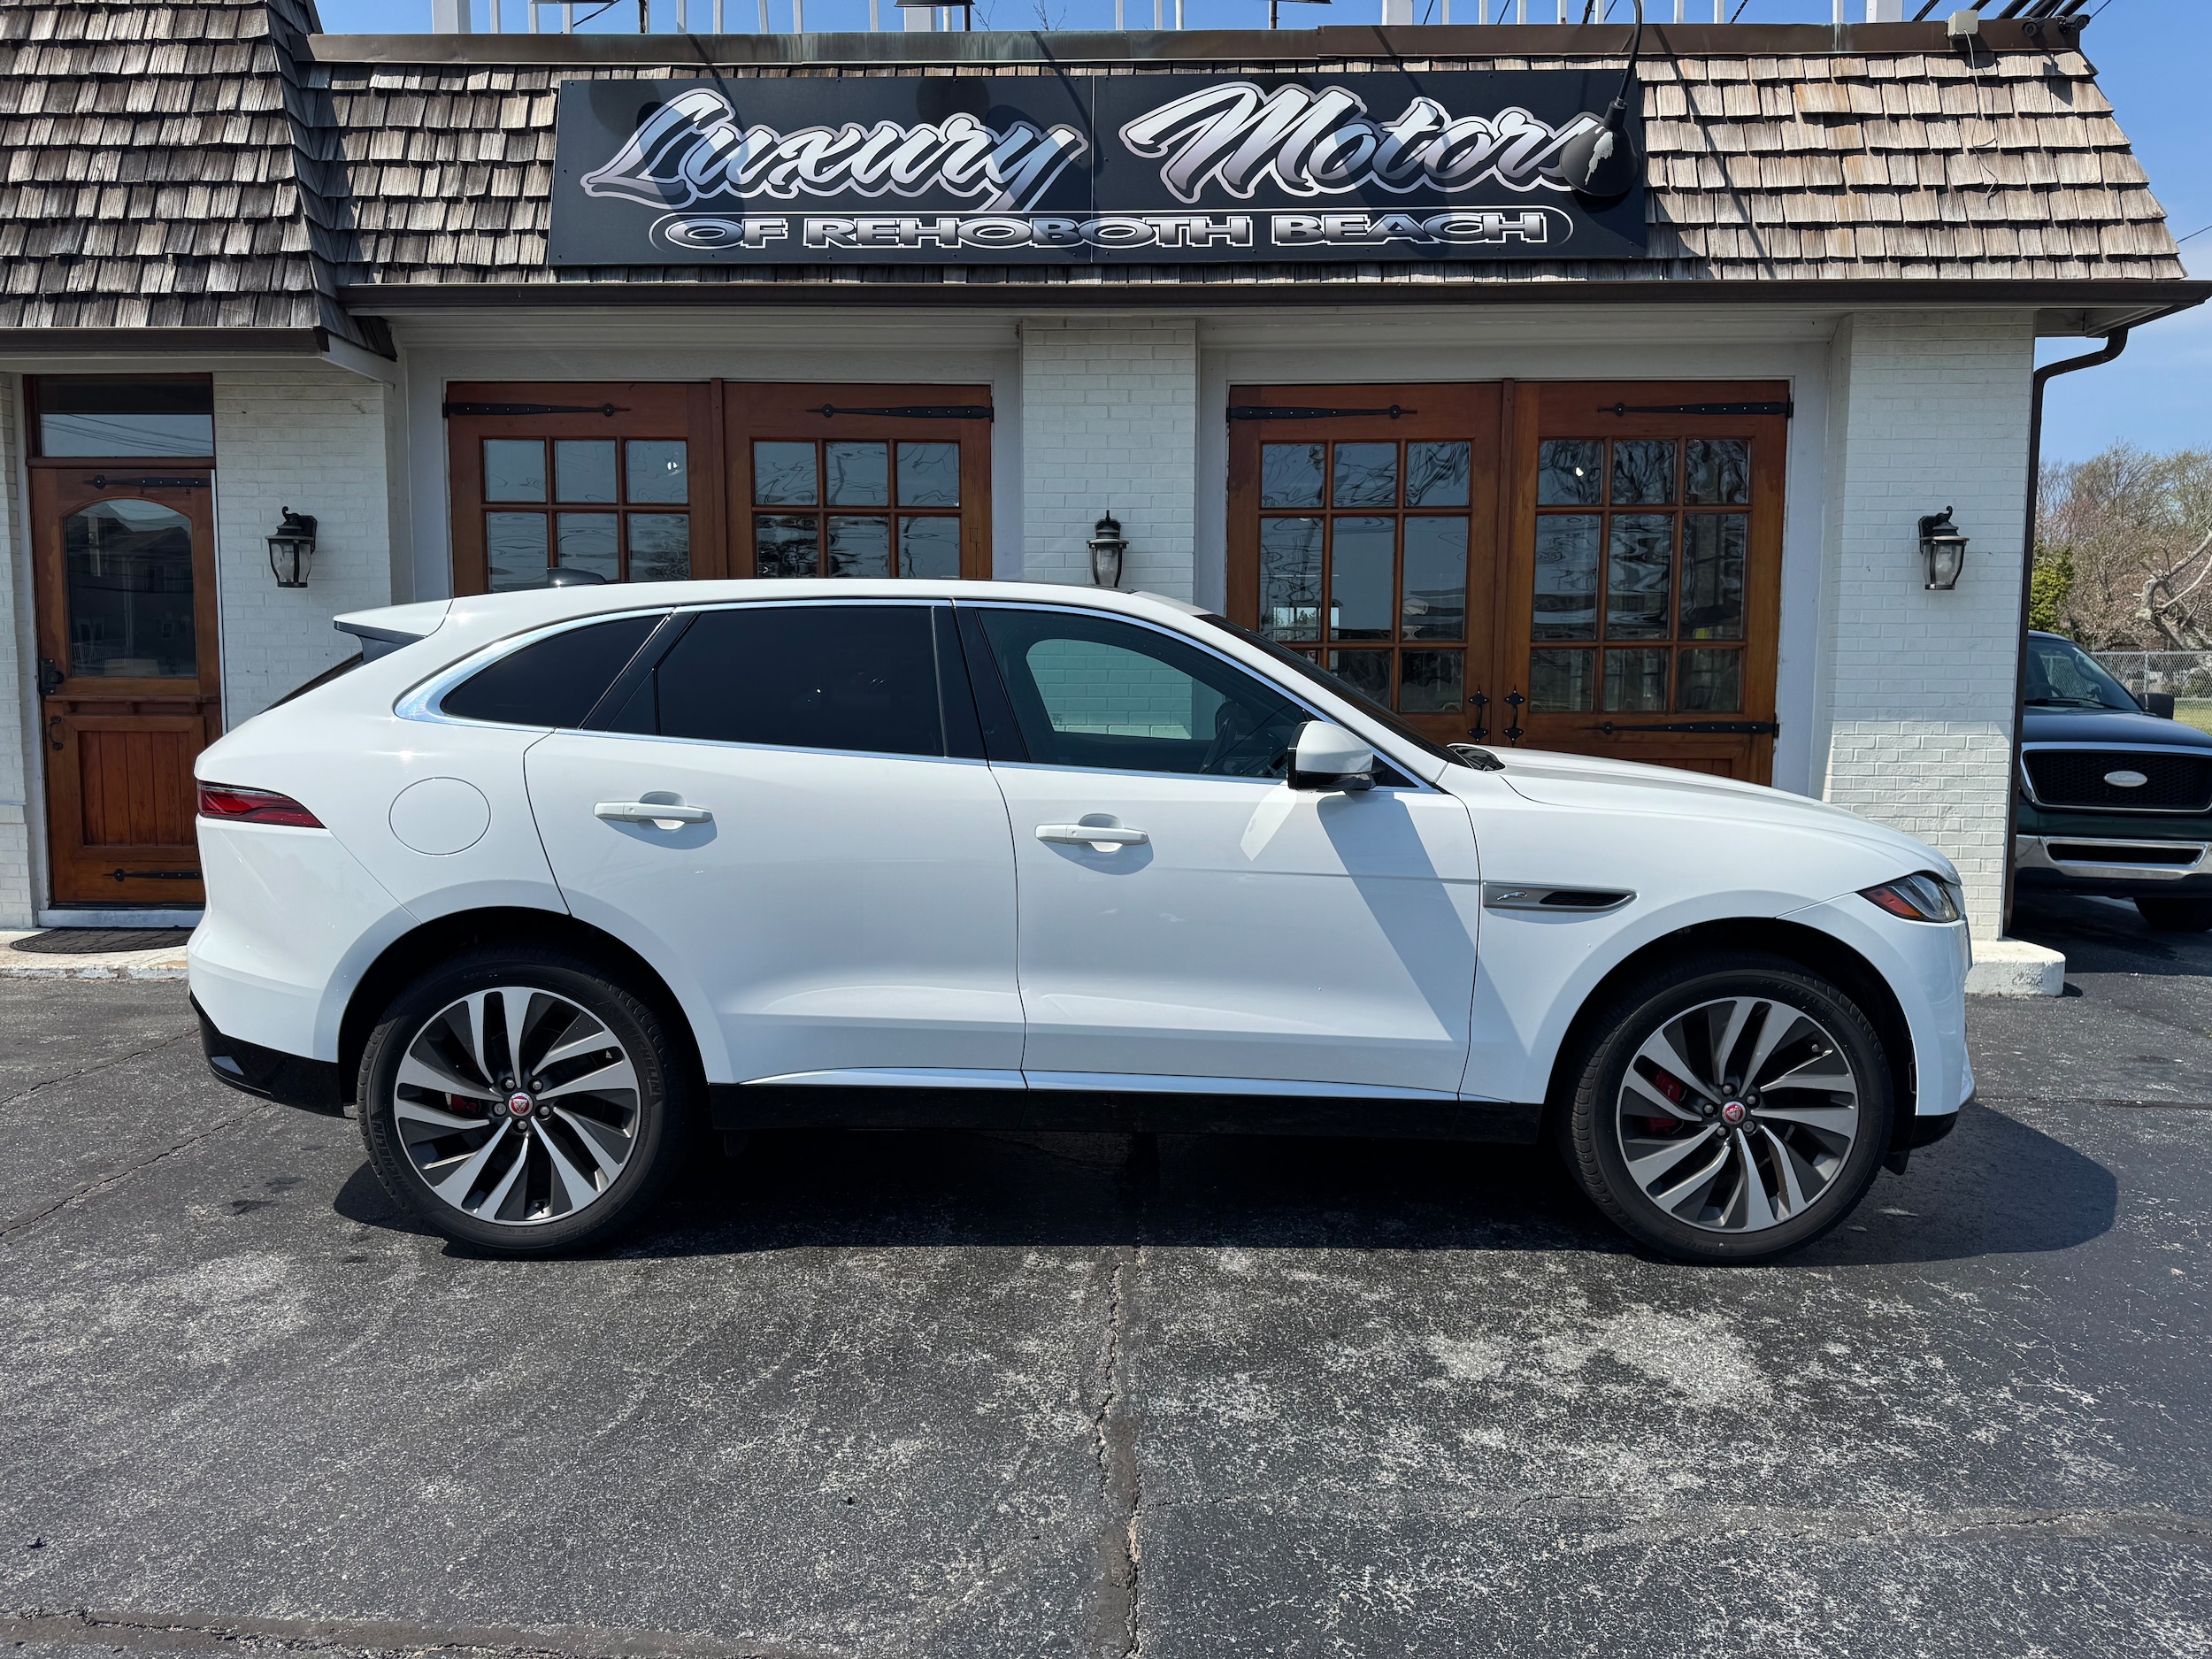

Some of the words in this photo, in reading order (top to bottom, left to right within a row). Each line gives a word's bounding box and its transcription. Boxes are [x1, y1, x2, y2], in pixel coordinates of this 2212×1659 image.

[580, 88, 1089, 211] Luxury
[665, 218, 788, 249] OF
[803, 215, 1253, 249] REHOBOTH
[1271, 212, 1548, 246] BEACH
